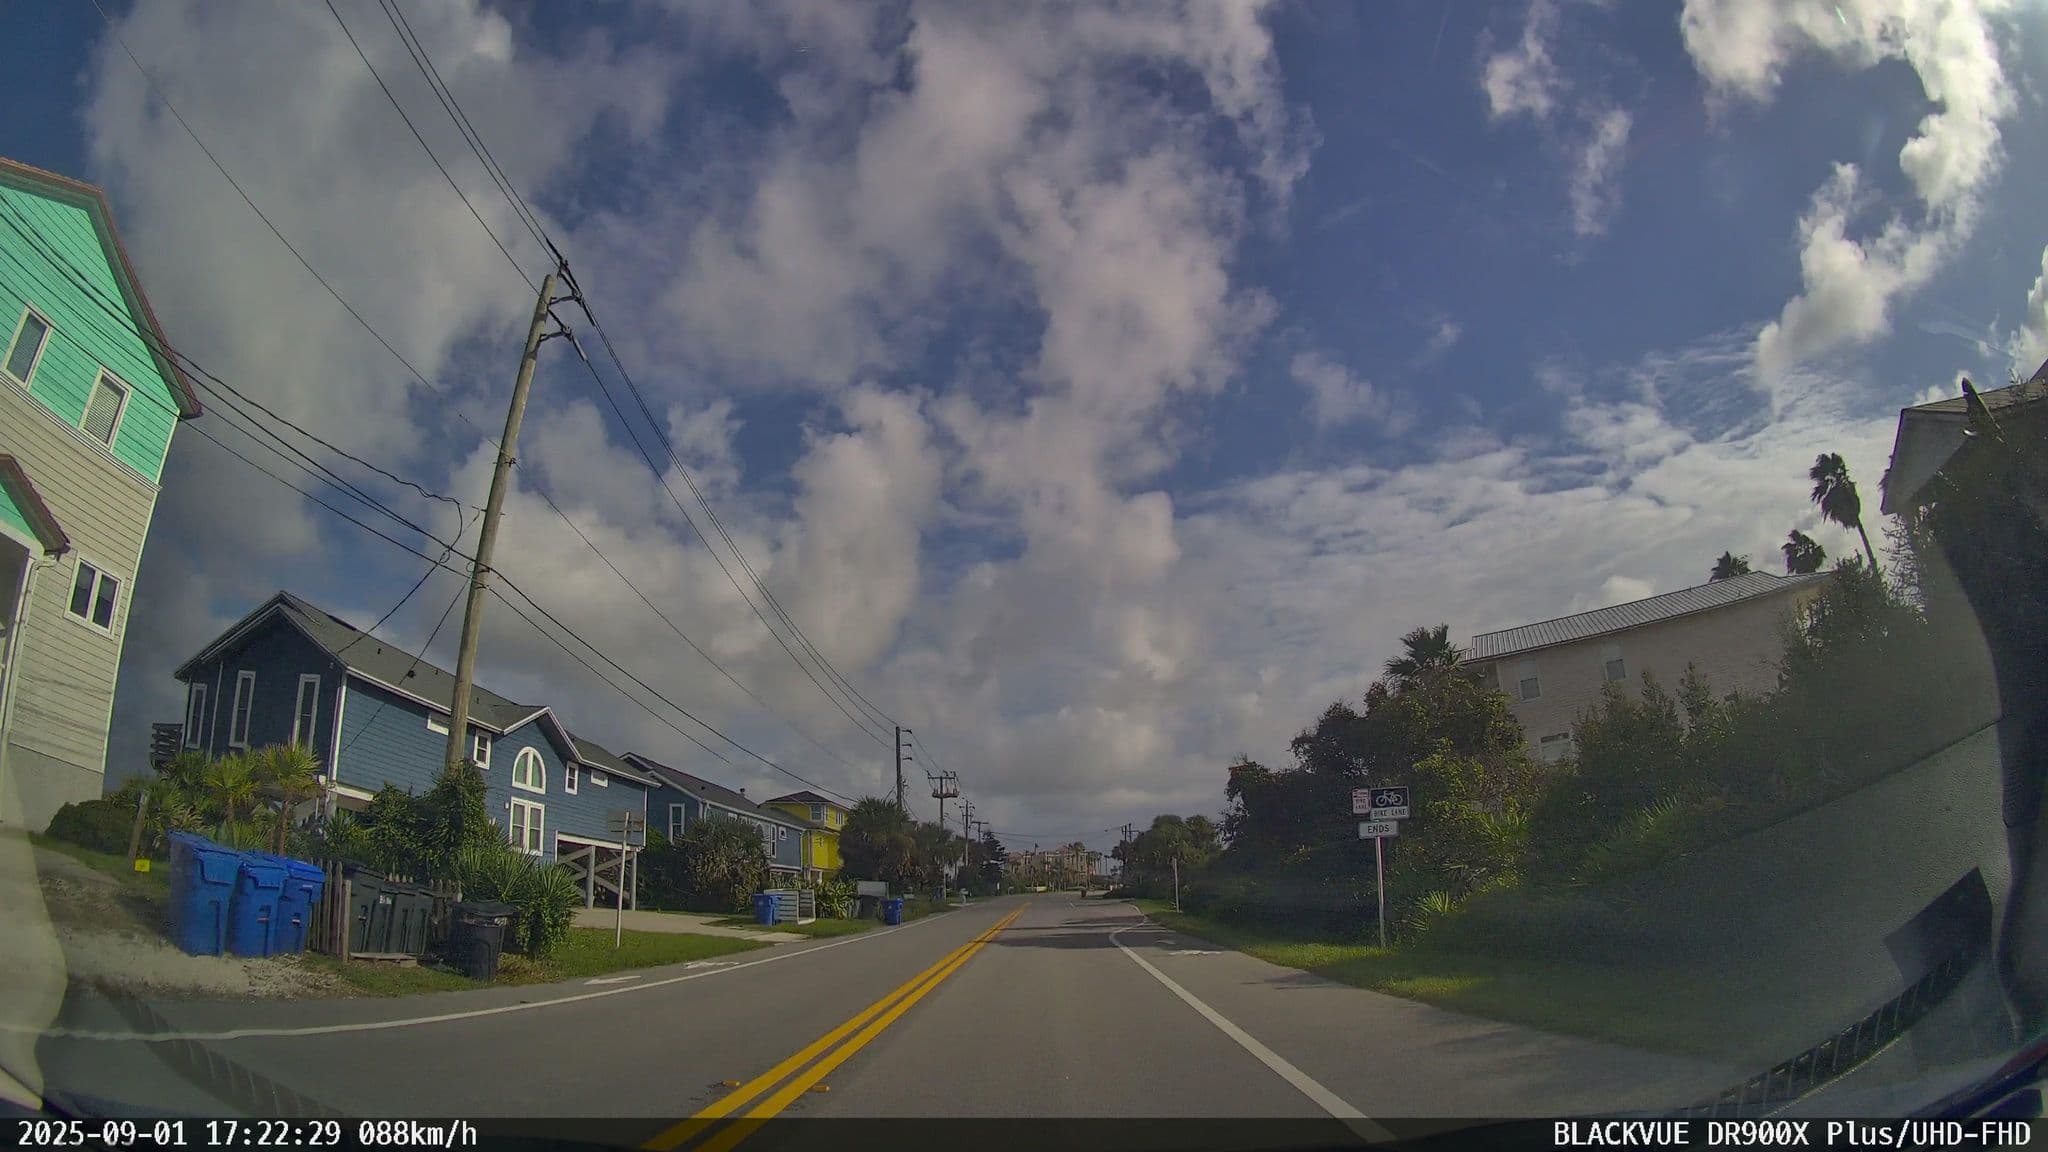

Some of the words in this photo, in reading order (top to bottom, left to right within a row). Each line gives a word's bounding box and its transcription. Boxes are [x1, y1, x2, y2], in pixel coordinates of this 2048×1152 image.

[1373, 809, 1388, 817] BIKE
[1391, 808, 1406, 816] LANE
[1367, 824, 1390, 833] ENDS
